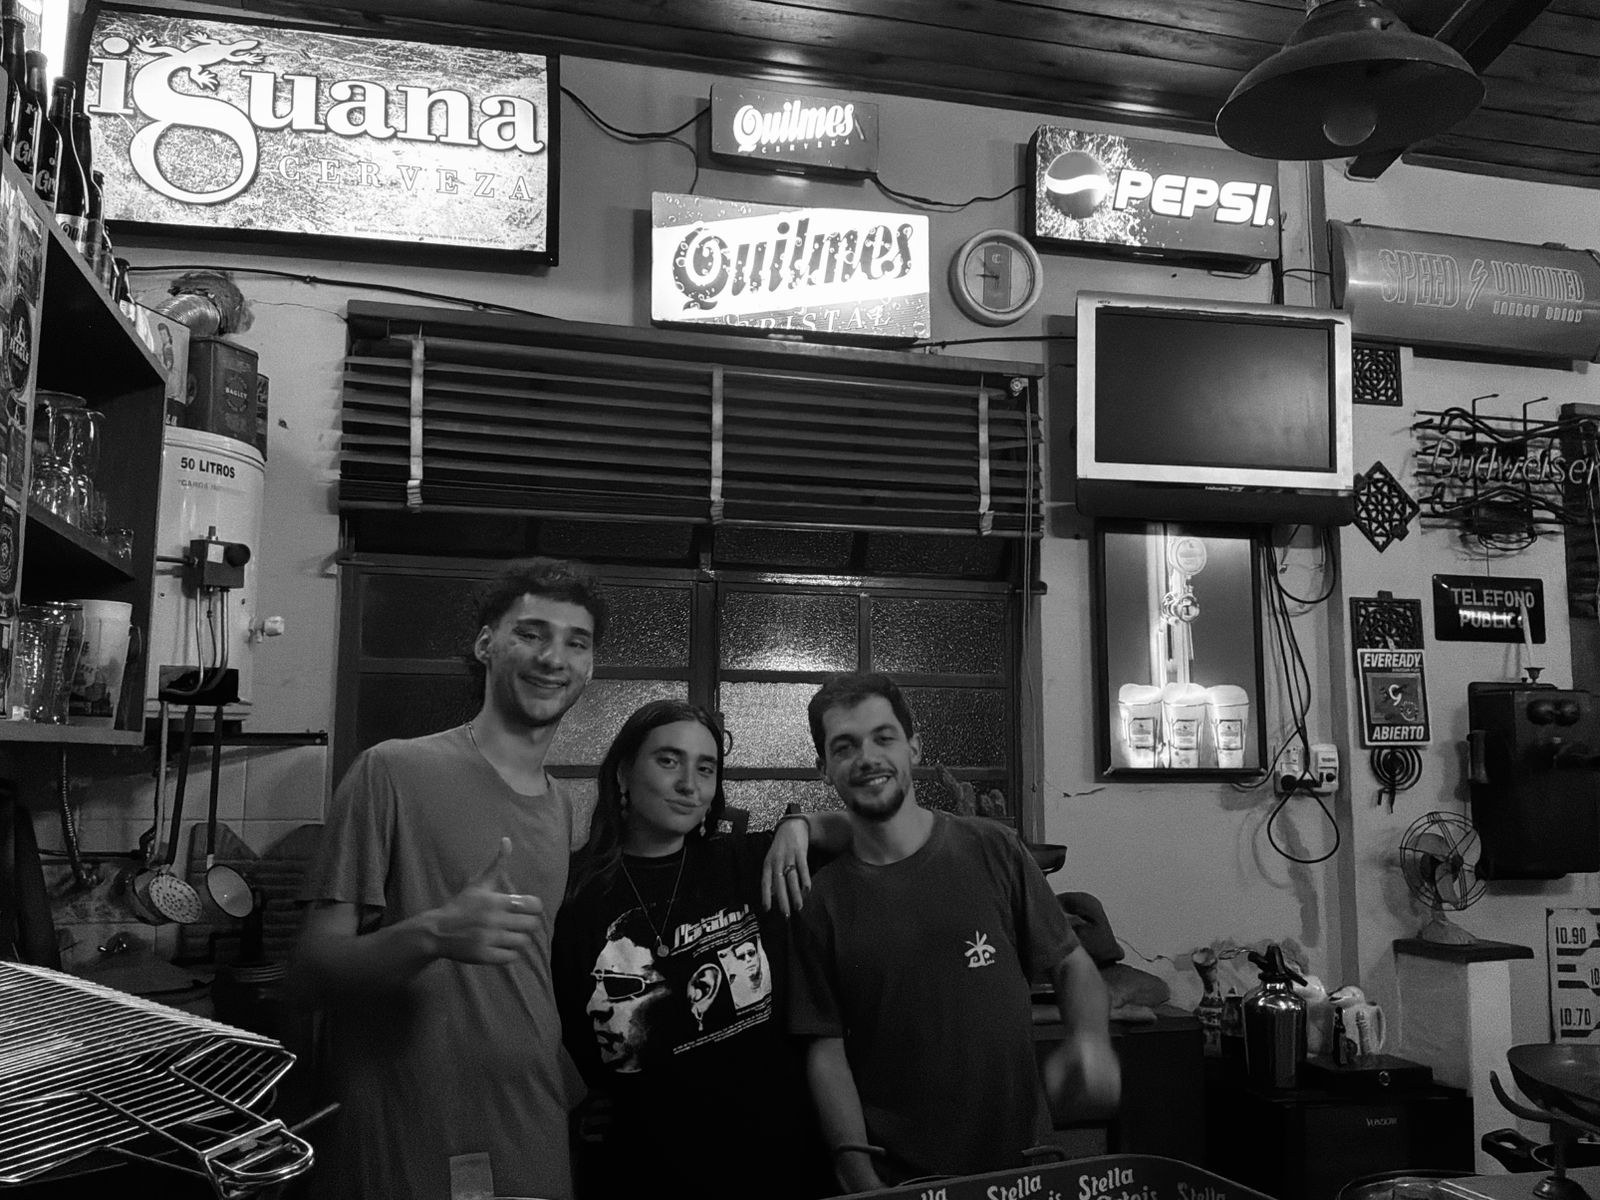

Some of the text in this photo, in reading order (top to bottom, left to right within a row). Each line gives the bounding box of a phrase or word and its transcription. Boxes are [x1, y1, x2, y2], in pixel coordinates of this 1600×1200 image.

[733, 100, 855, 153] Quilmes
[761, 138, 850, 154] CERVEZA
[277, 156, 534, 202] CERVEZA
[672, 217, 912, 312] Quilmes
[1378, 248, 1584, 308] SPEED UNLIMITED
[224, 387, 248, 400] BAGLEY
[180, 457, 236, 479] 50 LITROS
[1450, 587, 1535, 608] TELEFONO
[1363, 653, 1421, 668] EVEREADY
[1372, 725, 1424, 741] ABIERTO
[1556, 926, 1586, 944] 10.90
[1560, 1008, 1591, 1026] 10.70
[1078, 1167, 1134, 1200] Stella
